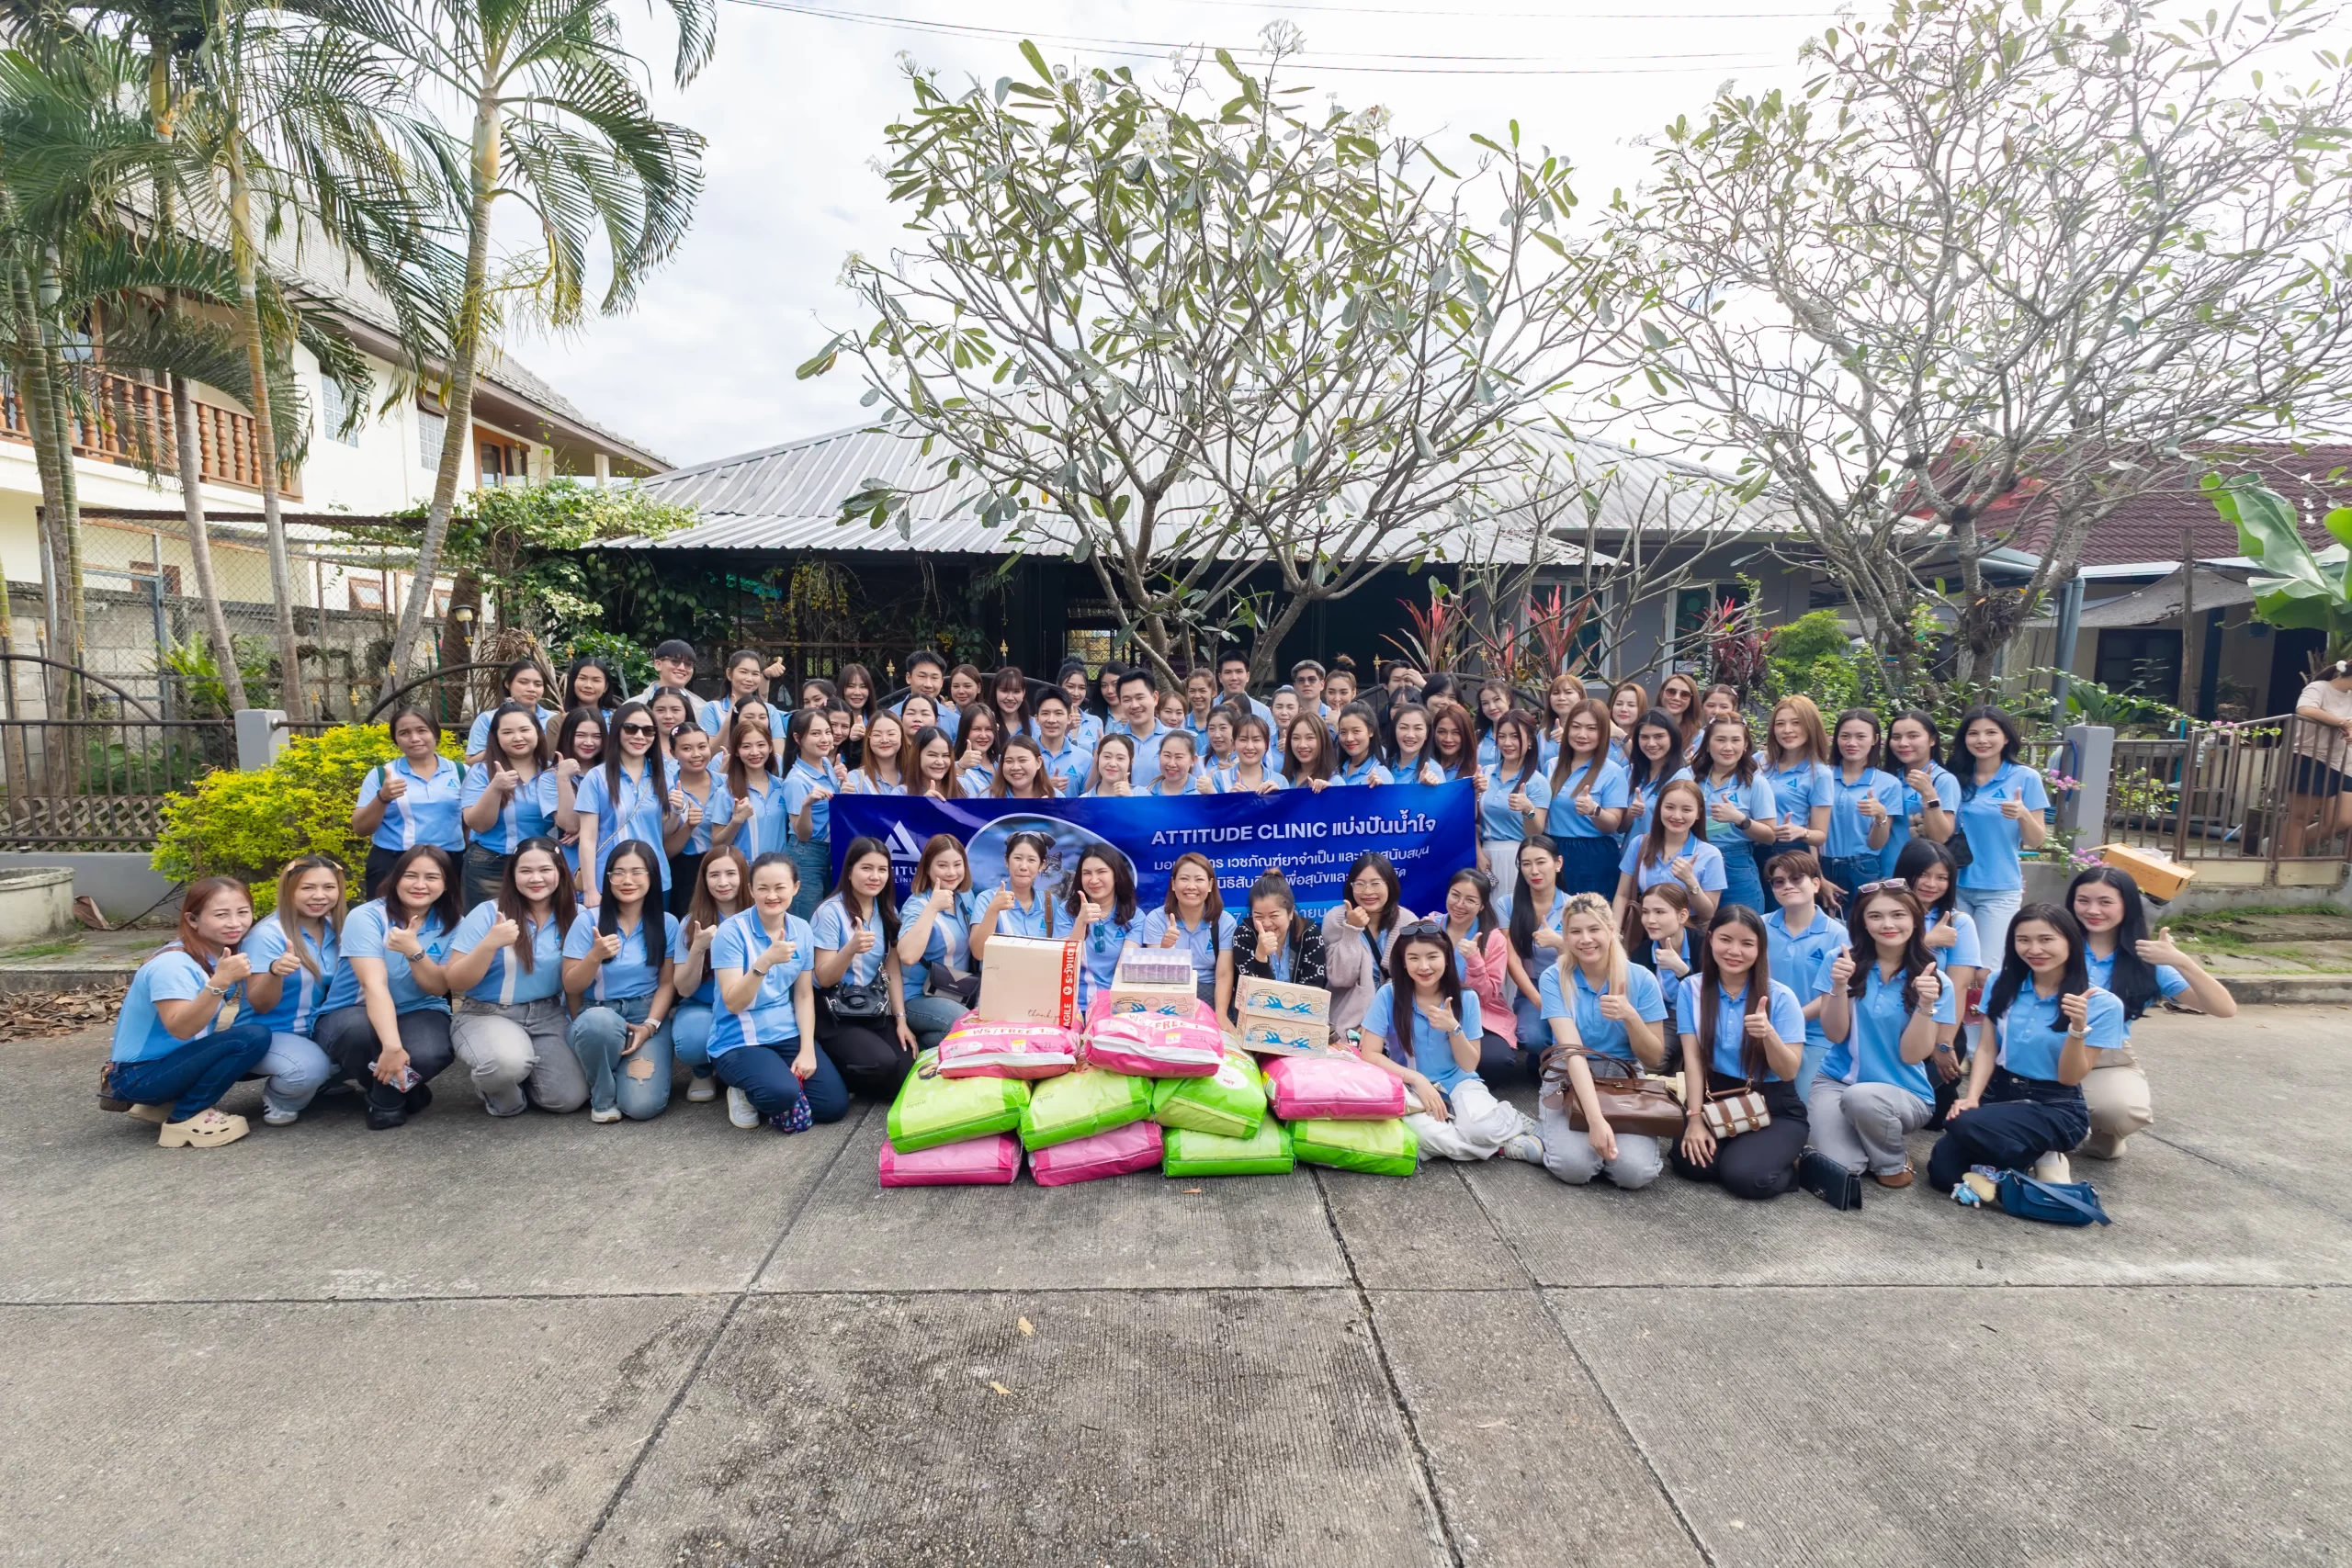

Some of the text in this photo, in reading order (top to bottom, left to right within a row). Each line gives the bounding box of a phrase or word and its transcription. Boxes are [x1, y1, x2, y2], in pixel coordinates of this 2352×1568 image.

[1150, 808, 1437, 845] ATTITUDE CLINIC แบ่งปันน้ำใจ
[1227, 849, 1335, 869] เวชภัณฑ์ยาจำเป็น
[1028, 1009, 1052, 1019] thank
[1062, 1003, 1073, 1027] AGILE
